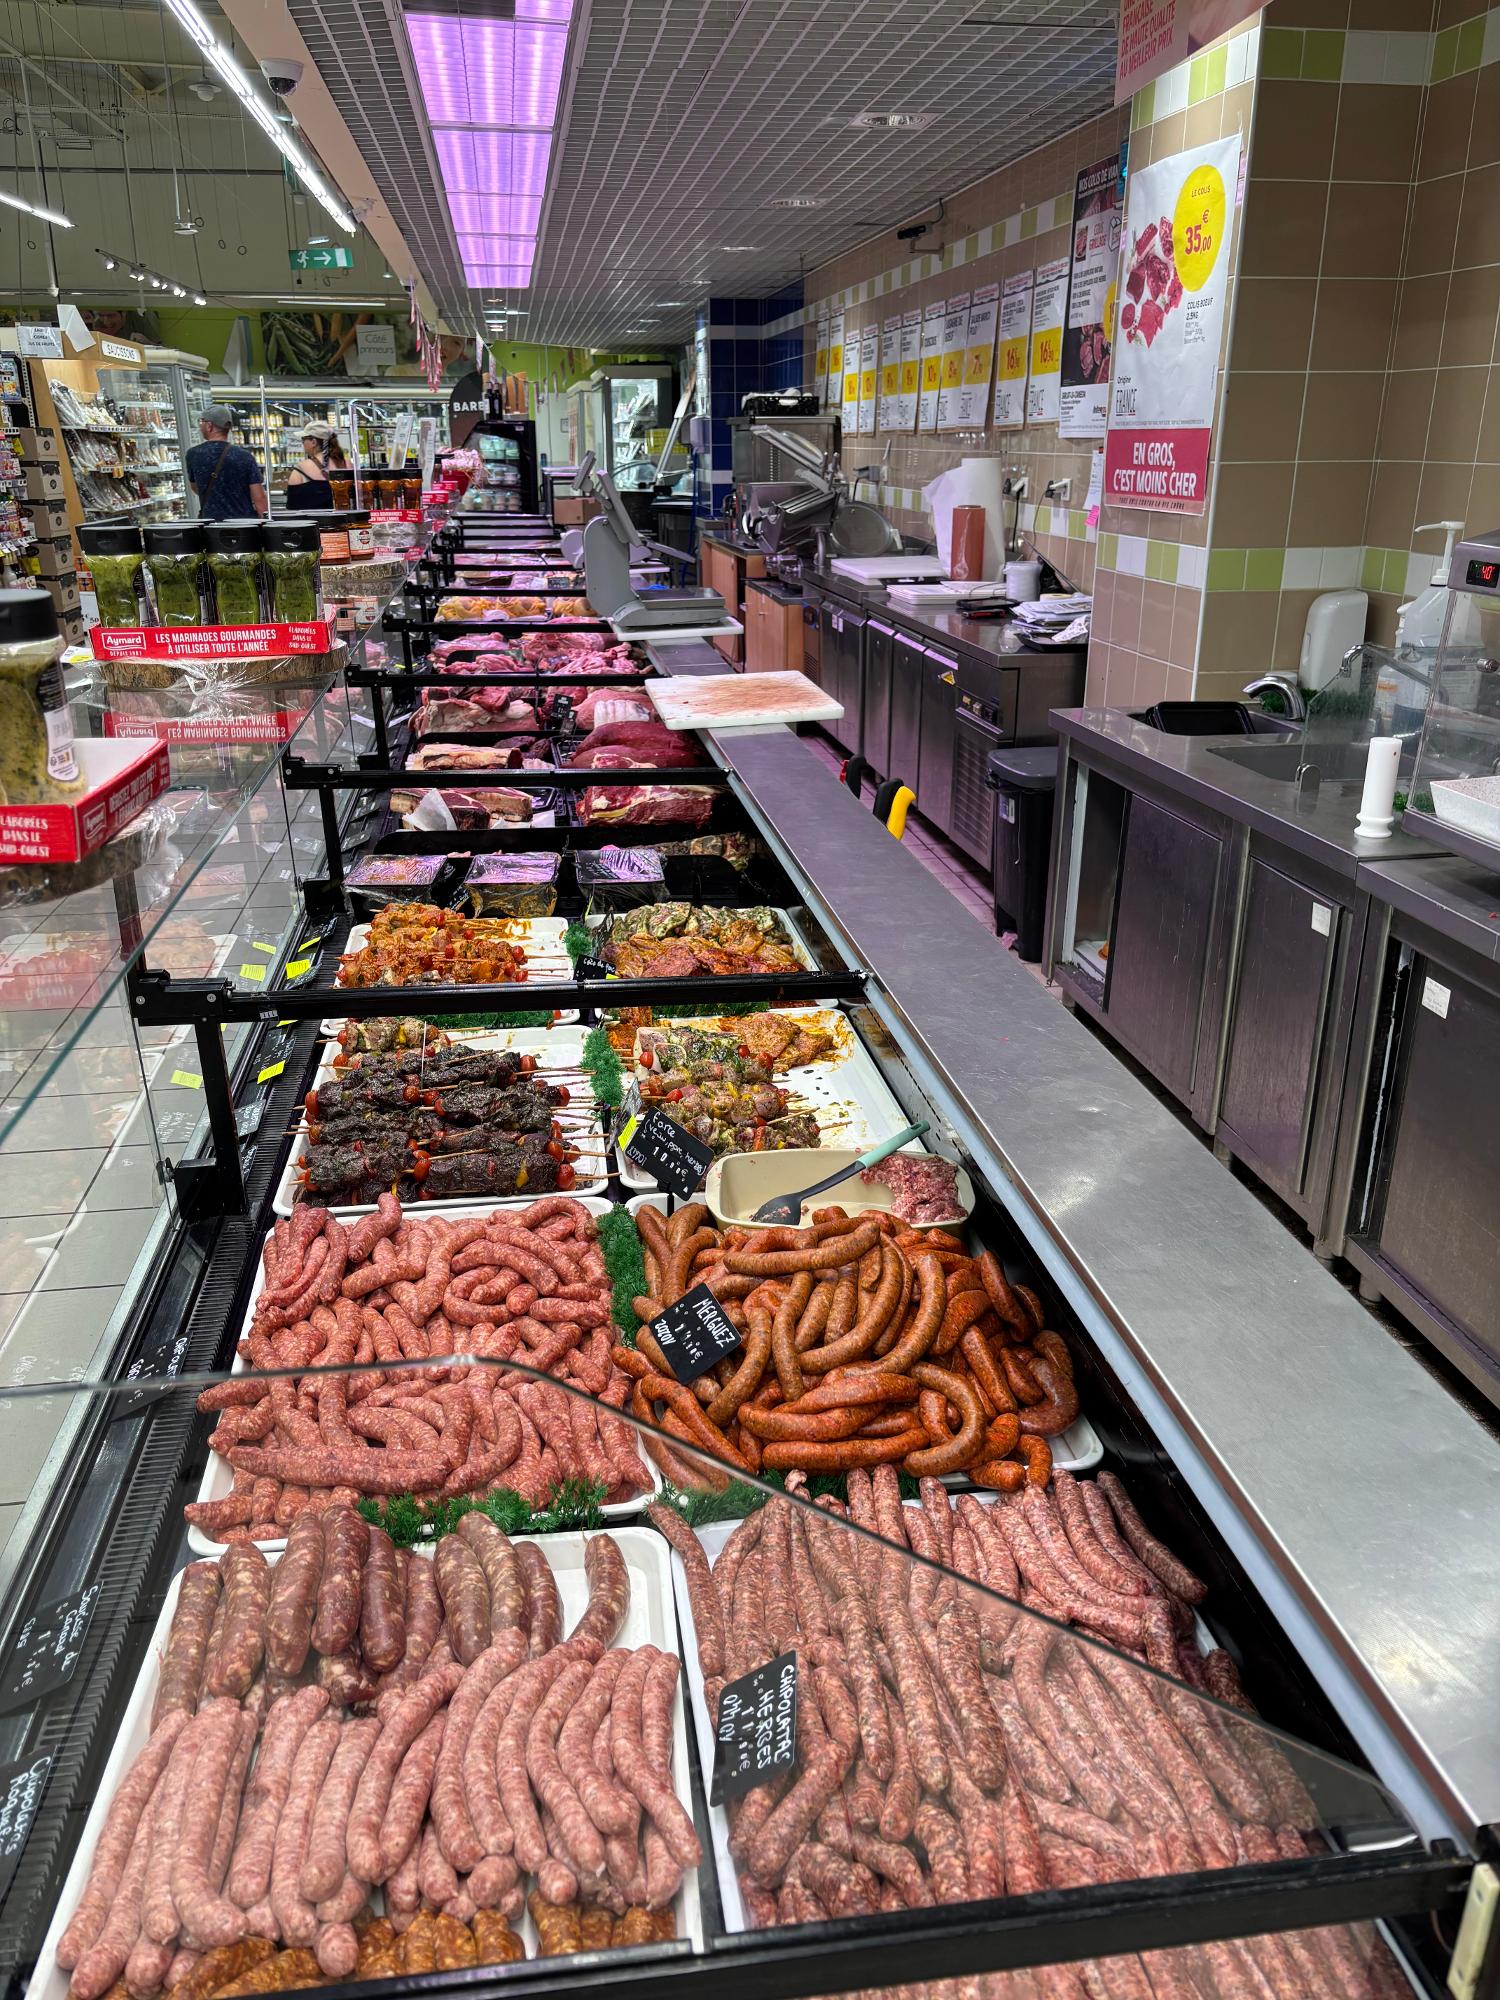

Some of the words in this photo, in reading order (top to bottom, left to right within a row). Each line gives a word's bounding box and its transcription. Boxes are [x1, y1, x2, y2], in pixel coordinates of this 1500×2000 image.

[1121, 34, 1130, 58] DE
[1130, 21, 1149, 51] HAUTE
[1120, 57, 1128, 79] AU
[1129, 42, 1157, 73] MEILLEUR
[1158, 24, 1174, 53] PRIX
[1191, 188, 1198, 198] LE
[1198, 184, 1211, 196] COLIS
[360, 346, 394, 356] primeurs
[1133, 442, 1145, 465] EN
[1147, 442, 1176, 471] GROS,
[1113, 468, 1136, 492] C'EST
[1136, 470, 1167, 495] MOINS
[1168, 471, 1197, 497] CHER
[106, 636, 142, 646] Aymard
[155, 633, 170, 644] LES
[172, 631, 219, 643] MARINADES
[220, 629, 277, 642] GOURMANDES
[168, 641, 174, 654] À
[175, 643, 210, 654] UTILISER
[211, 642, 236, 653] TOUTE
[237, 640, 269, 652] L'ANNÉE
[3, 830, 30, 842] DANS
[31, 831, 41, 842] LE
[692, 1297, 736, 1348] MERGUEZ
[756, 1689, 775, 1769] HERBES
